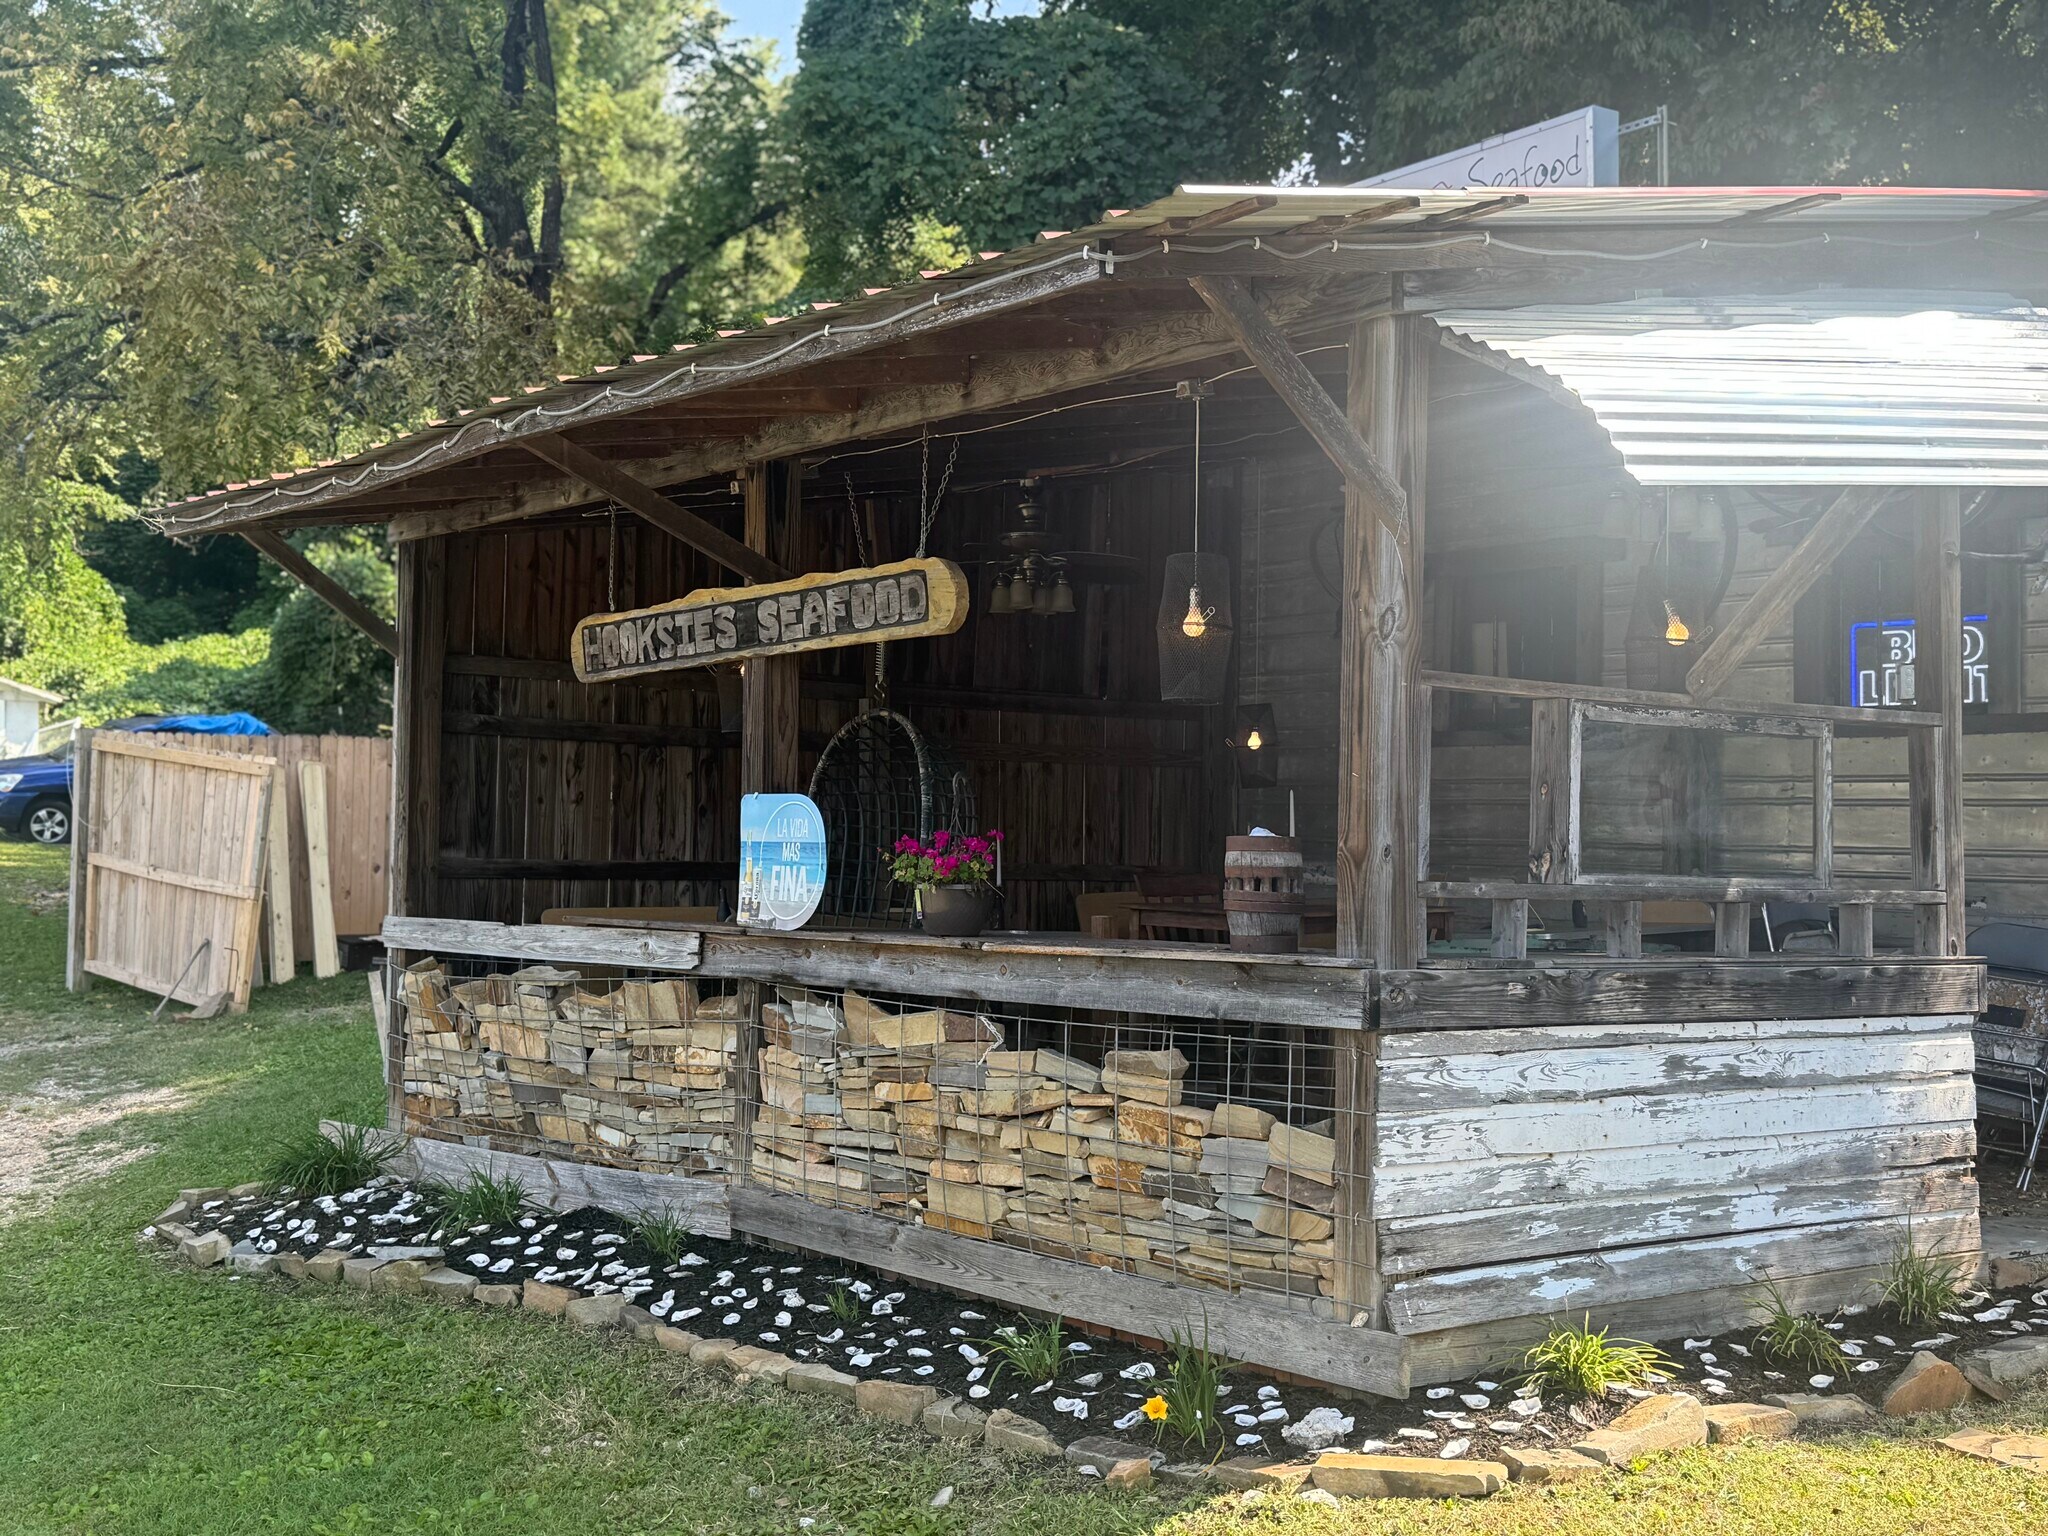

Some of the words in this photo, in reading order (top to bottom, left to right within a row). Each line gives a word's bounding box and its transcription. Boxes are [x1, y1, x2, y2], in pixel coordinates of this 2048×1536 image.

[1468, 134, 1582, 188] Seafood
[583, 605, 737, 673] HOOKSIES
[757, 575, 928, 644] SEAFOOD
[777, 818, 788, 838] LA
[790, 817, 809, 838] VIDA
[770, 865, 808, 902] FINA
